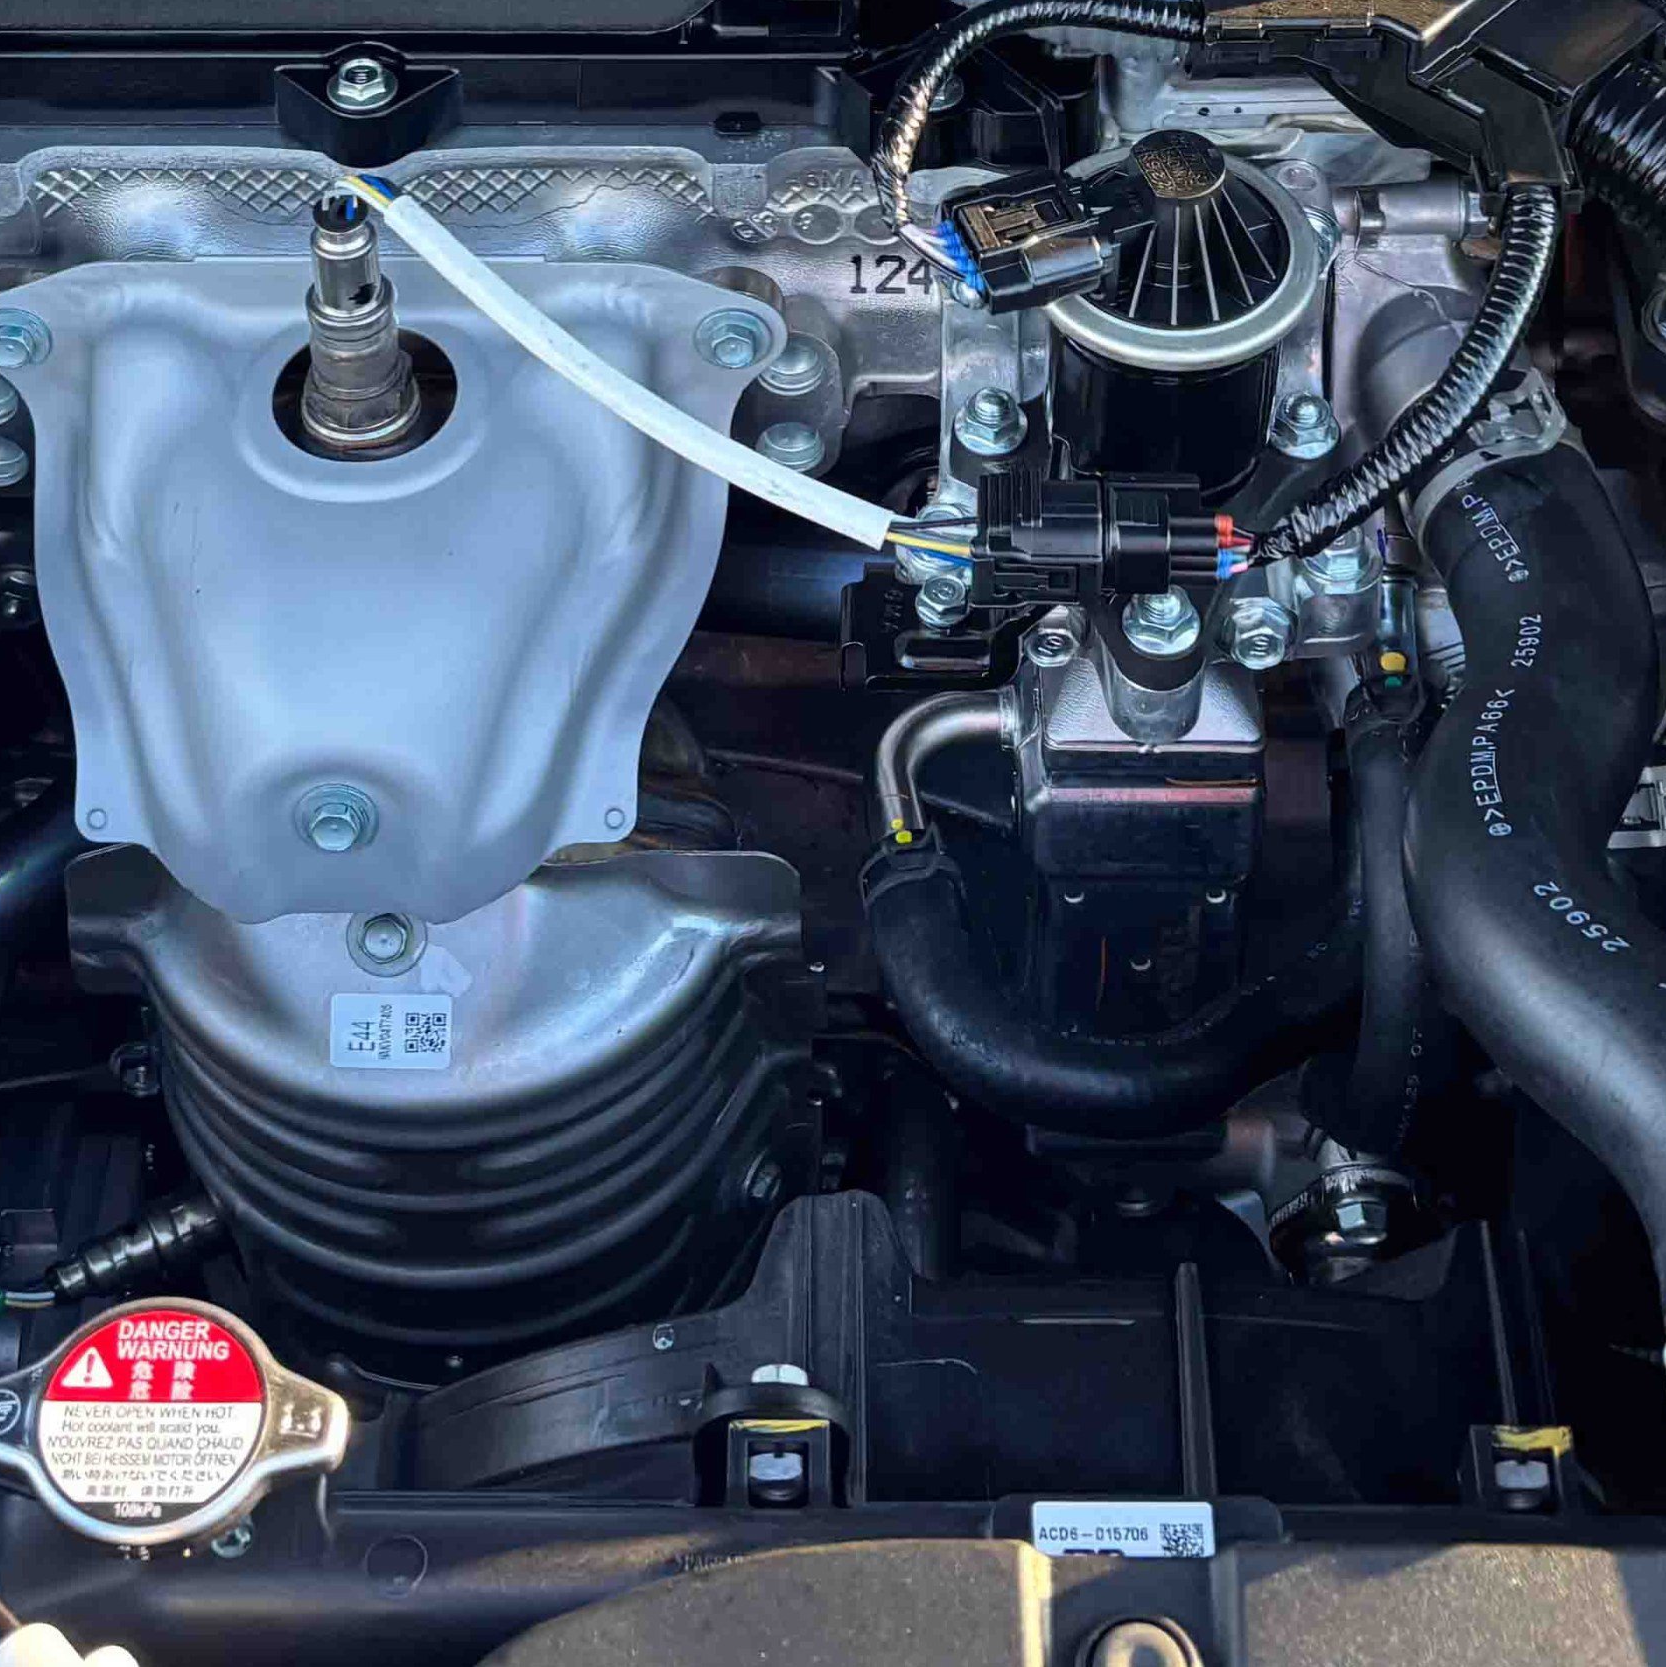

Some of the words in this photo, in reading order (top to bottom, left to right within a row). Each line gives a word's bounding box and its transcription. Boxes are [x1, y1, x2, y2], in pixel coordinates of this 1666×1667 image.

[847, 253, 933, 295] 124
[1510, 613, 1543, 668] 25902
[1533, 880, 1632, 953] 25902
[348, 1020, 377, 1053] E44
[118, 1319, 210, 1341] DANGER
[117, 1341, 230, 1361] WARNUNG
[64, 1405, 111, 1419] NEVER
[116, 1405, 156, 1419] OPEN
[159, 1405, 202, 1419] WHEN
[62, 1421, 84, 1433] Hot
[87, 1421, 133, 1433] coolant
[136, 1421, 156, 1433] will
[159, 1421, 192, 1433] scald
[195, 1422, 221, 1435] you.
[117, 1436, 143, 1450] PAS
[146, 1436, 194, 1450] QUAND
[153, 1452, 191, 1466] MOTOR
[1038, 1525, 1150, 1543] ACD6-015706
